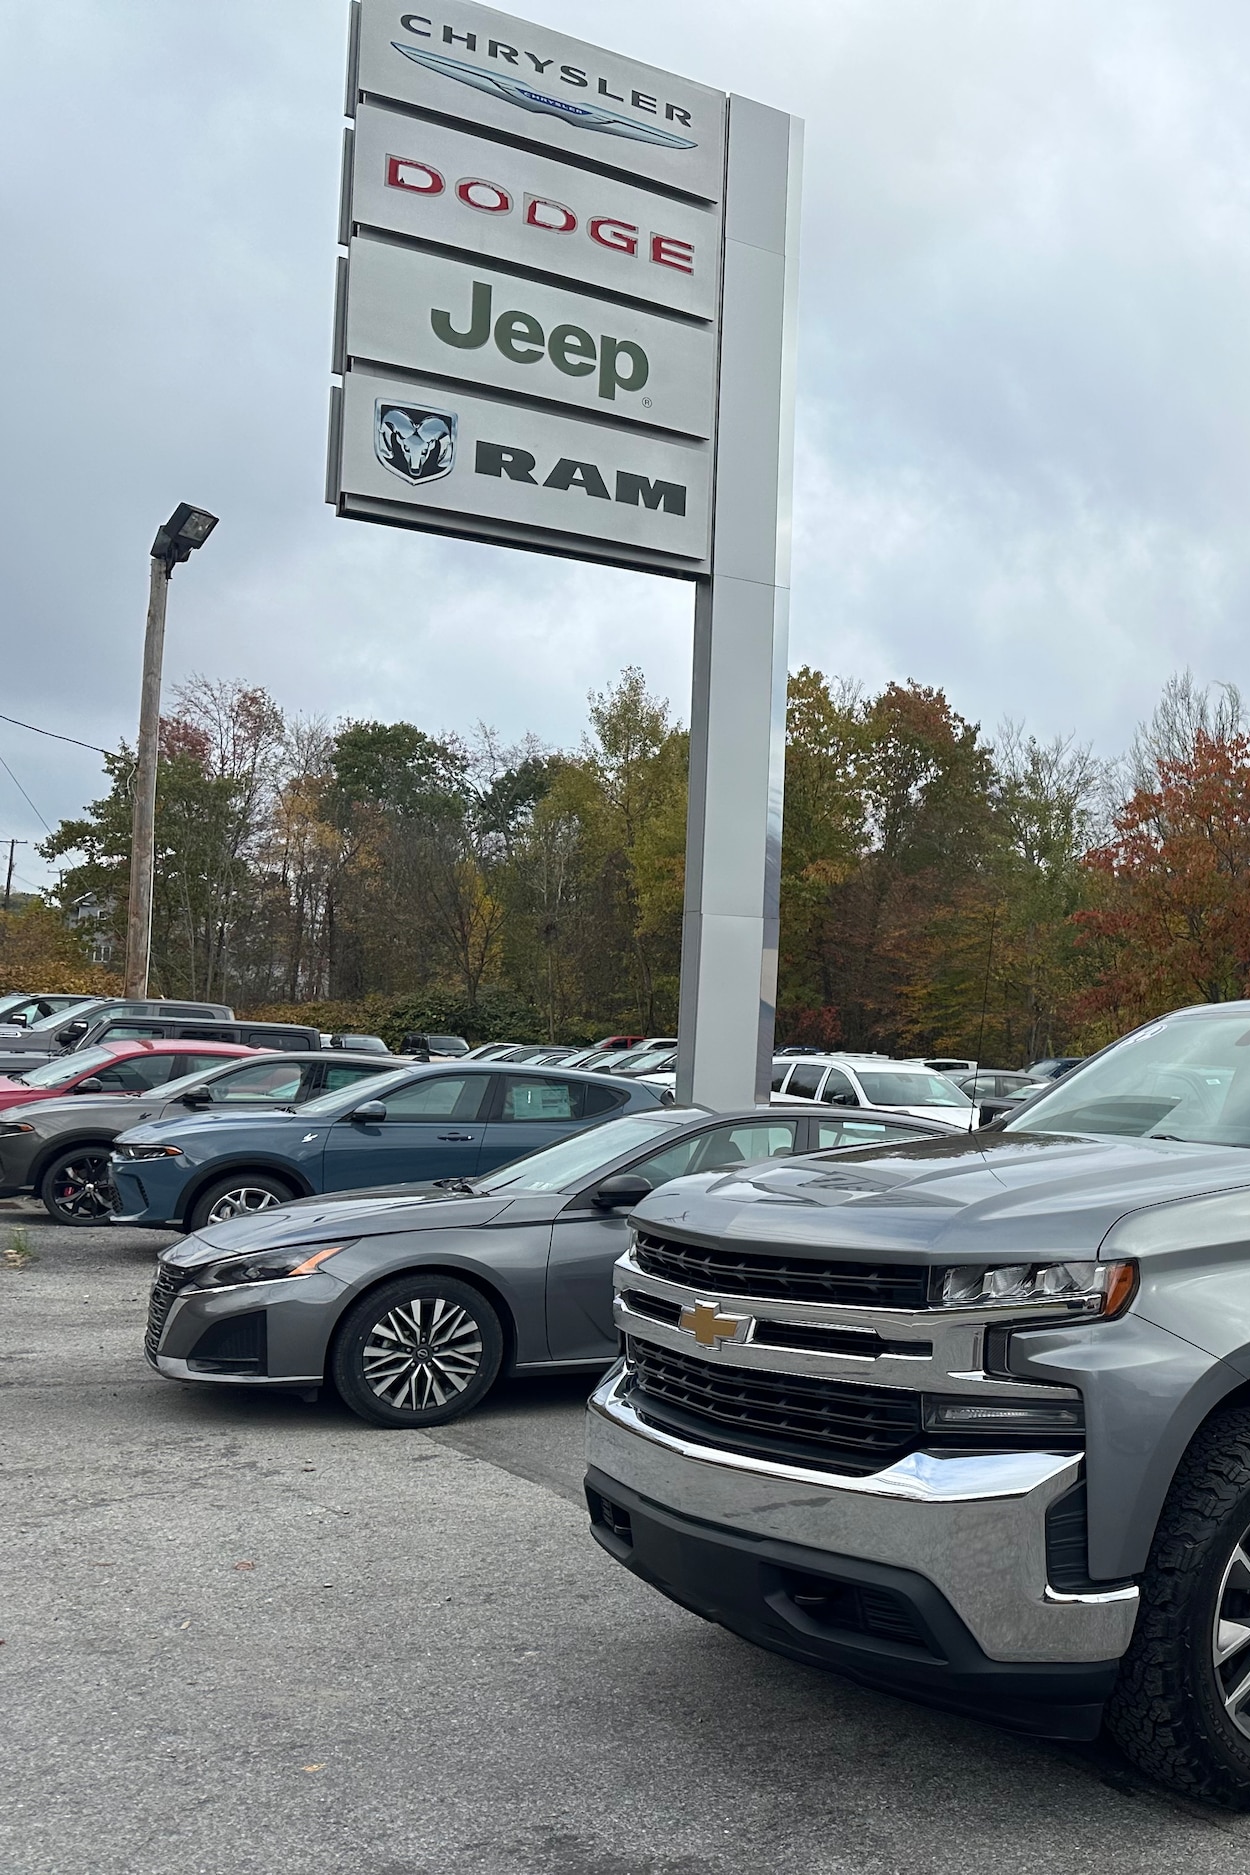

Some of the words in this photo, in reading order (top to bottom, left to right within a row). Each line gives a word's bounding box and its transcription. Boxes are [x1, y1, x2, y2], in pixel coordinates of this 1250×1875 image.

[399, 14, 693, 129] CHRYSLER
[523, 91, 583, 114] CHRYSLER
[384, 153, 696, 276] DODGE
[430, 280, 650, 401] Jeep
[474, 440, 688, 518] RAM
